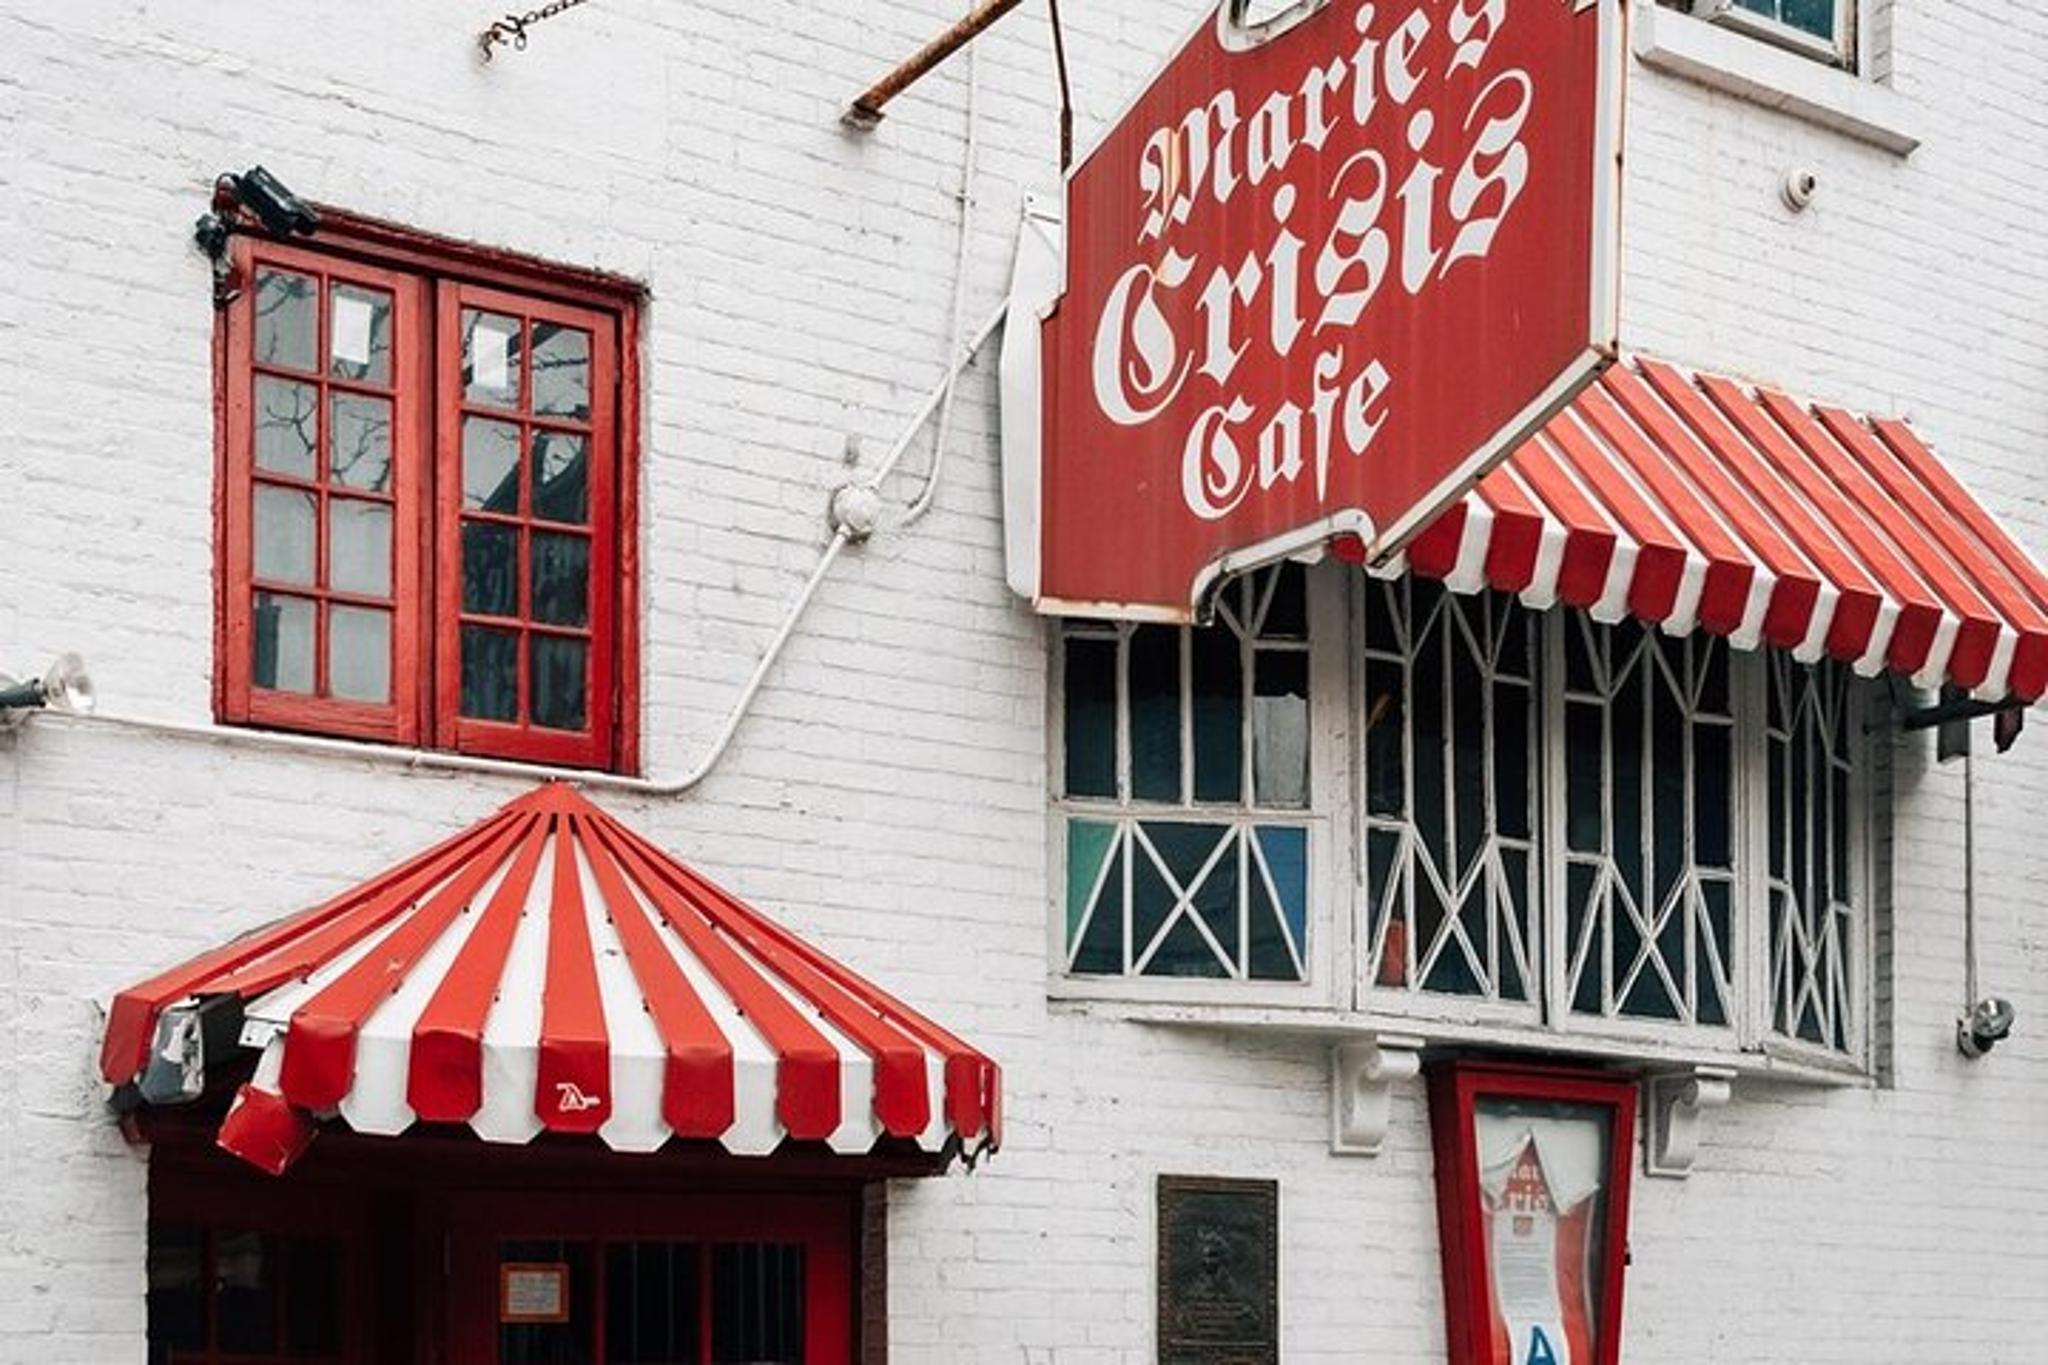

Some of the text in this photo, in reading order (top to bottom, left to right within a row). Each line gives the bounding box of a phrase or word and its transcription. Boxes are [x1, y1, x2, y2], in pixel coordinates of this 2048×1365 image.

[1139, 0, 1505, 244] Maries
[1093, 68, 1533, 426] Crisis
[1182, 344, 1391, 519] Cafe
[1527, 1325, 1557, 1365] A
